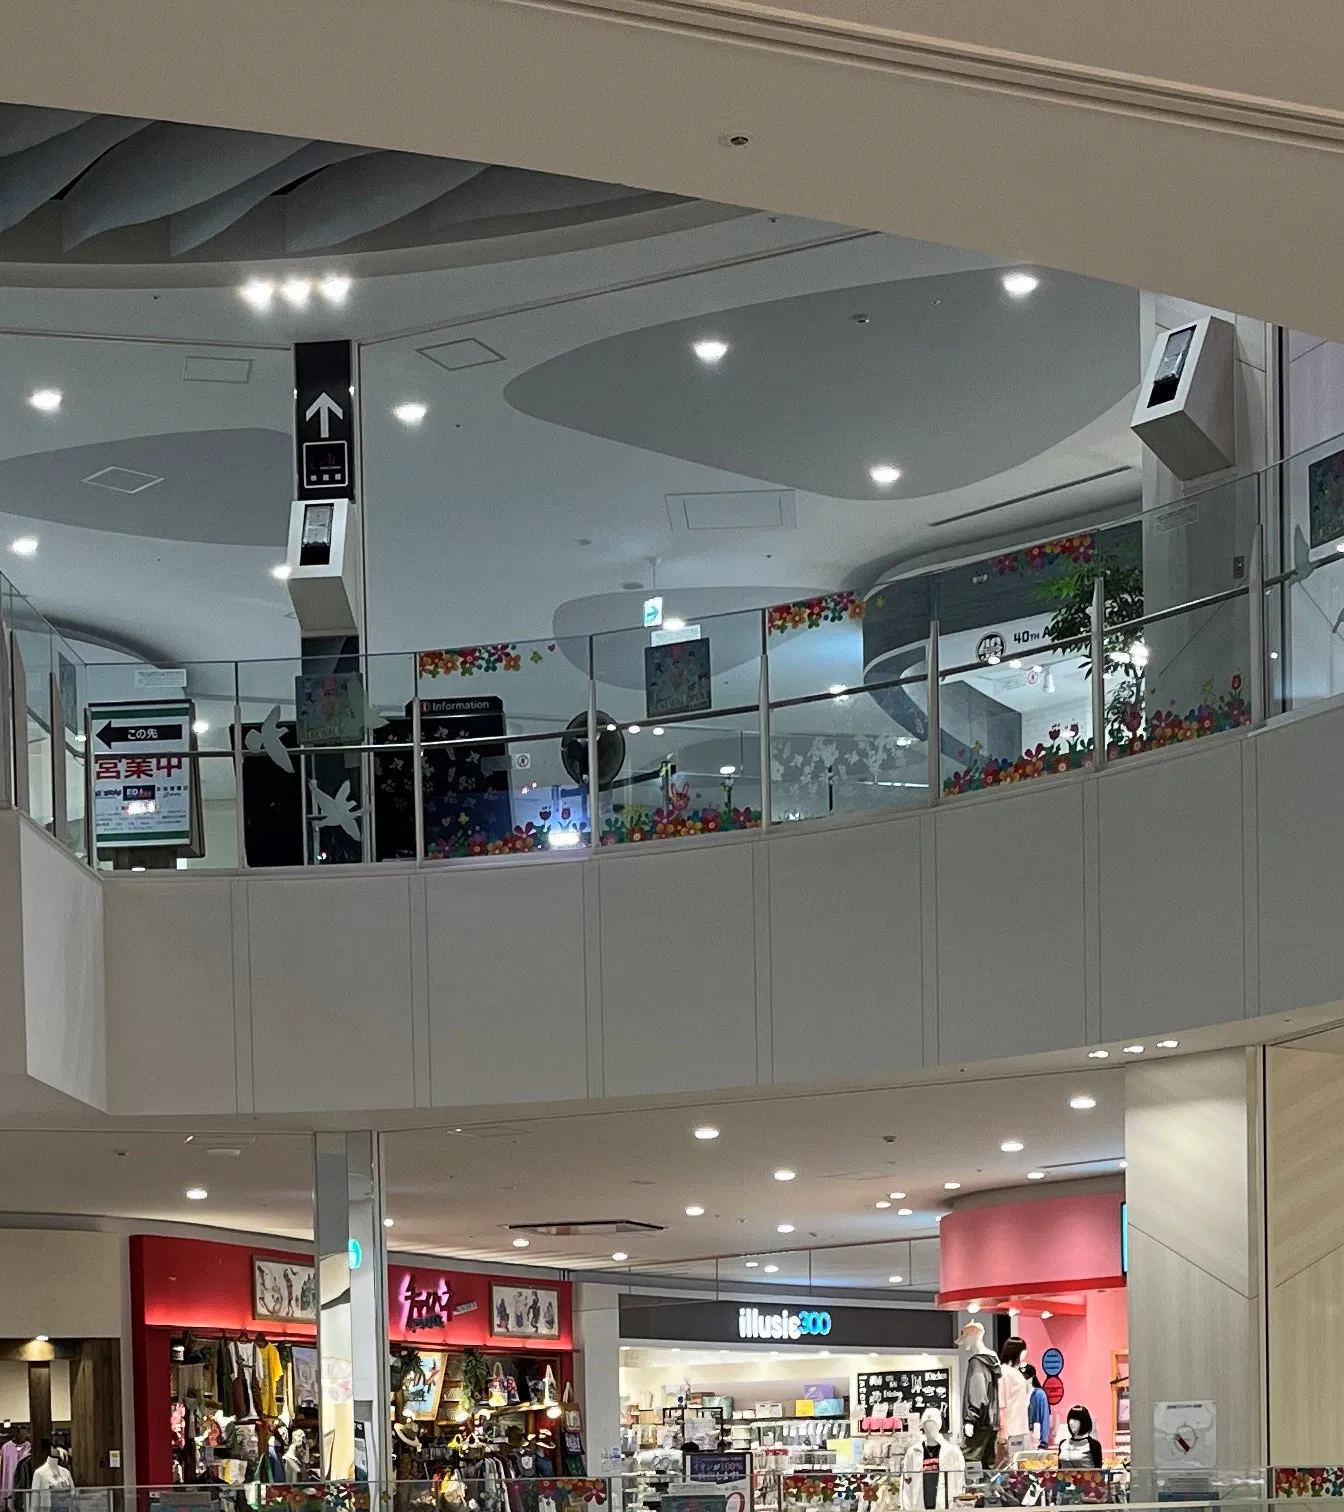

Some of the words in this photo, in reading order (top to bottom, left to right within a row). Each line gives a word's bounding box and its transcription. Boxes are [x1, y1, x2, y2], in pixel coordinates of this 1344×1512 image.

[432, 701, 489, 711] Information
[127, 728, 158, 740] この先
[94, 755, 183, 781] 営業中
